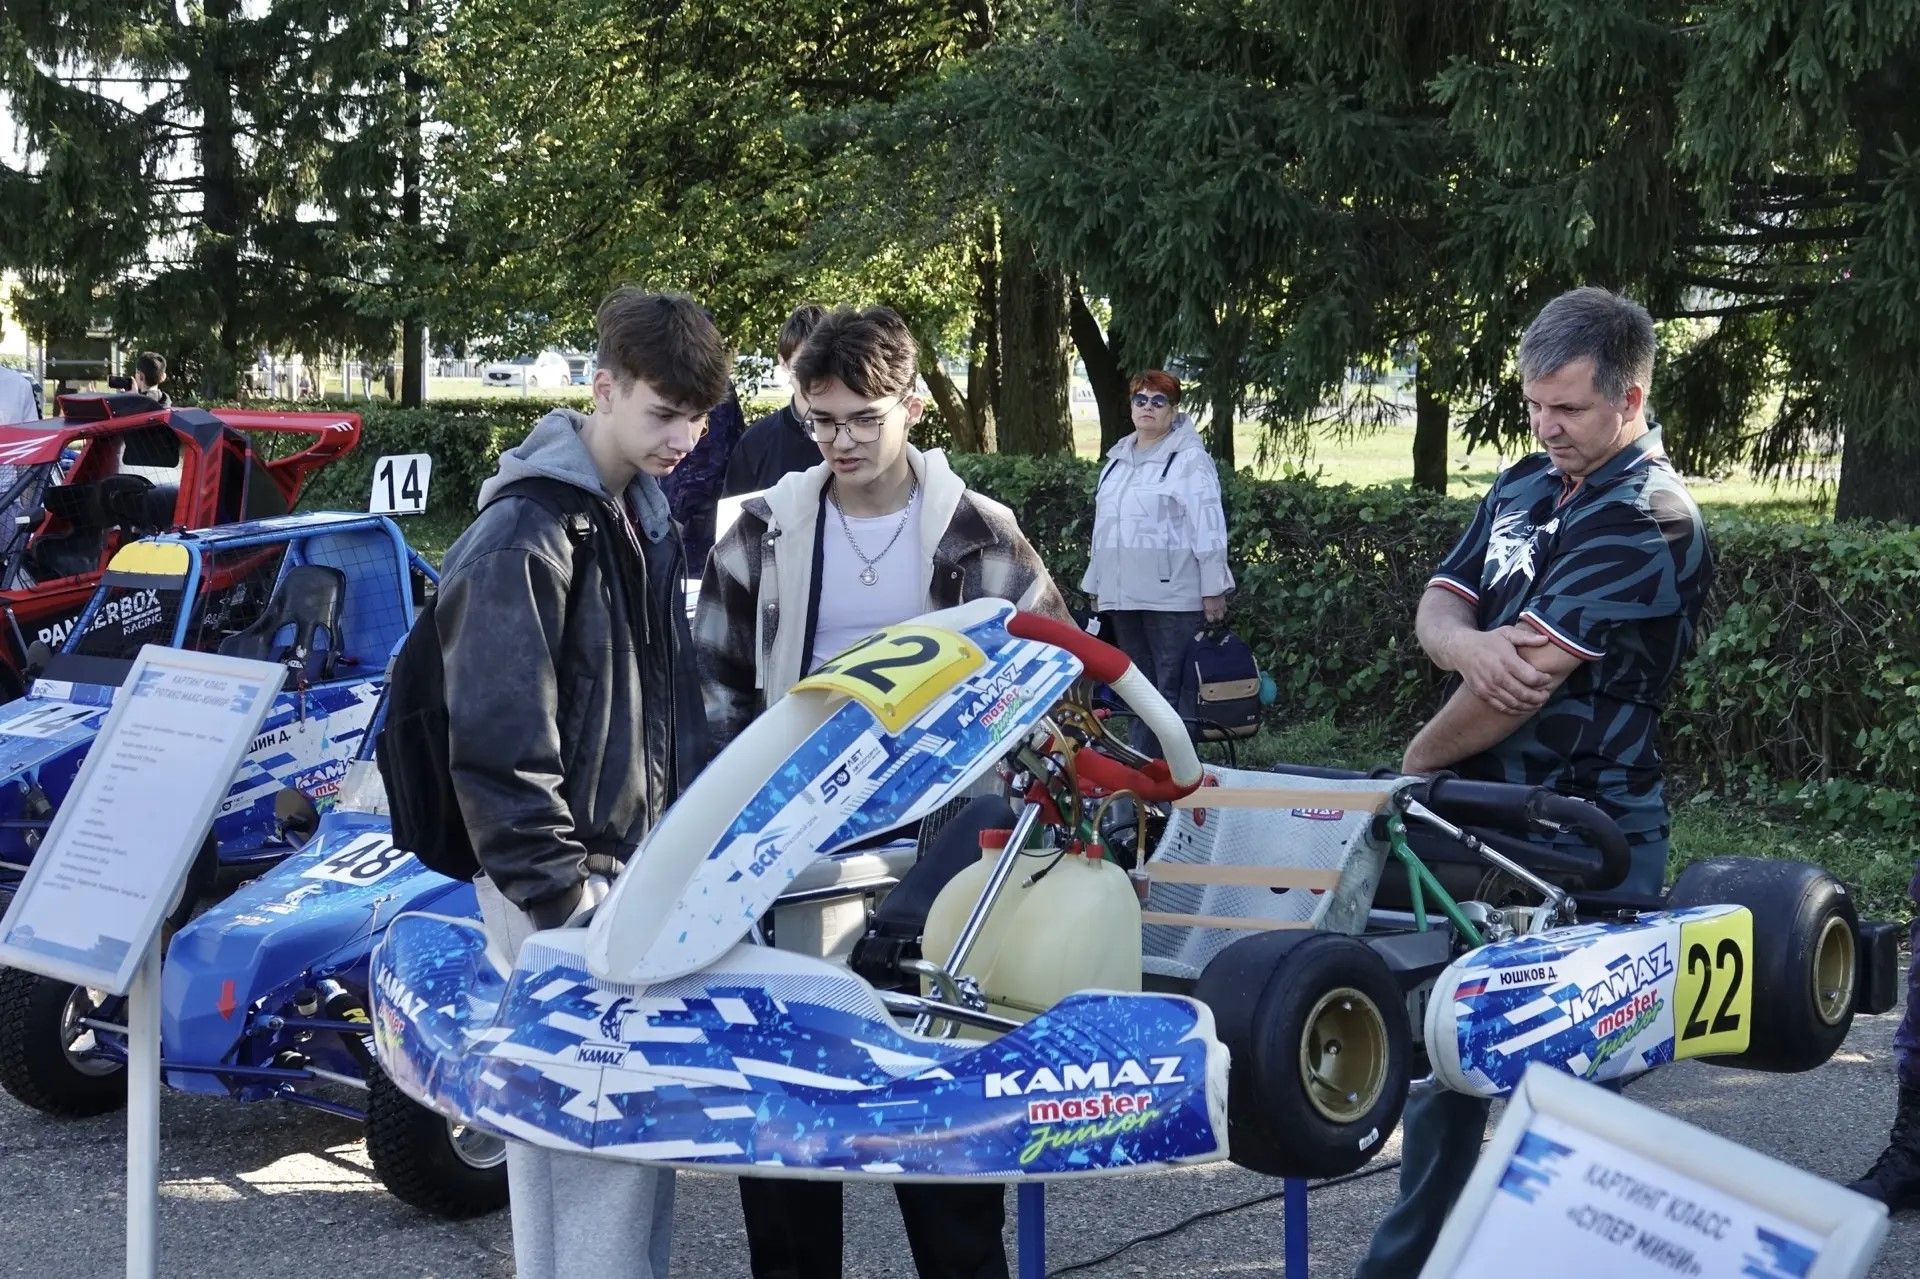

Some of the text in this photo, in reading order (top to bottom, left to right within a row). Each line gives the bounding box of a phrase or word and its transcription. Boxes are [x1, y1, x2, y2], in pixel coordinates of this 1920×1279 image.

[380, 459, 422, 510] 14
[122, 613, 162, 636] RACING
[957, 663, 1022, 728] KAMAZ
[980, 688, 1020, 727] master
[279, 730, 291, 744] Д.
[295, 757, 354, 789] KAM
[820, 763, 851, 804] 50
[325, 840, 401, 879] 48
[376, 963, 429, 1024] KAMAZ
[1500, 967, 1546, 985] ЮШКОВ
[1570, 942, 1674, 1025] KAMAZ
[1681, 938, 1744, 1041] 22
[1597, 989, 1659, 1039] master
[578, 1049, 624, 1066] KAMAZ
[985, 1056, 1185, 1098] KAMAZ
[1030, 1092, 1151, 1123] master
[1019, 1108, 1160, 1165] Junior
[1584, 1162, 1732, 1240] КАРТИНГ КЛАСС
